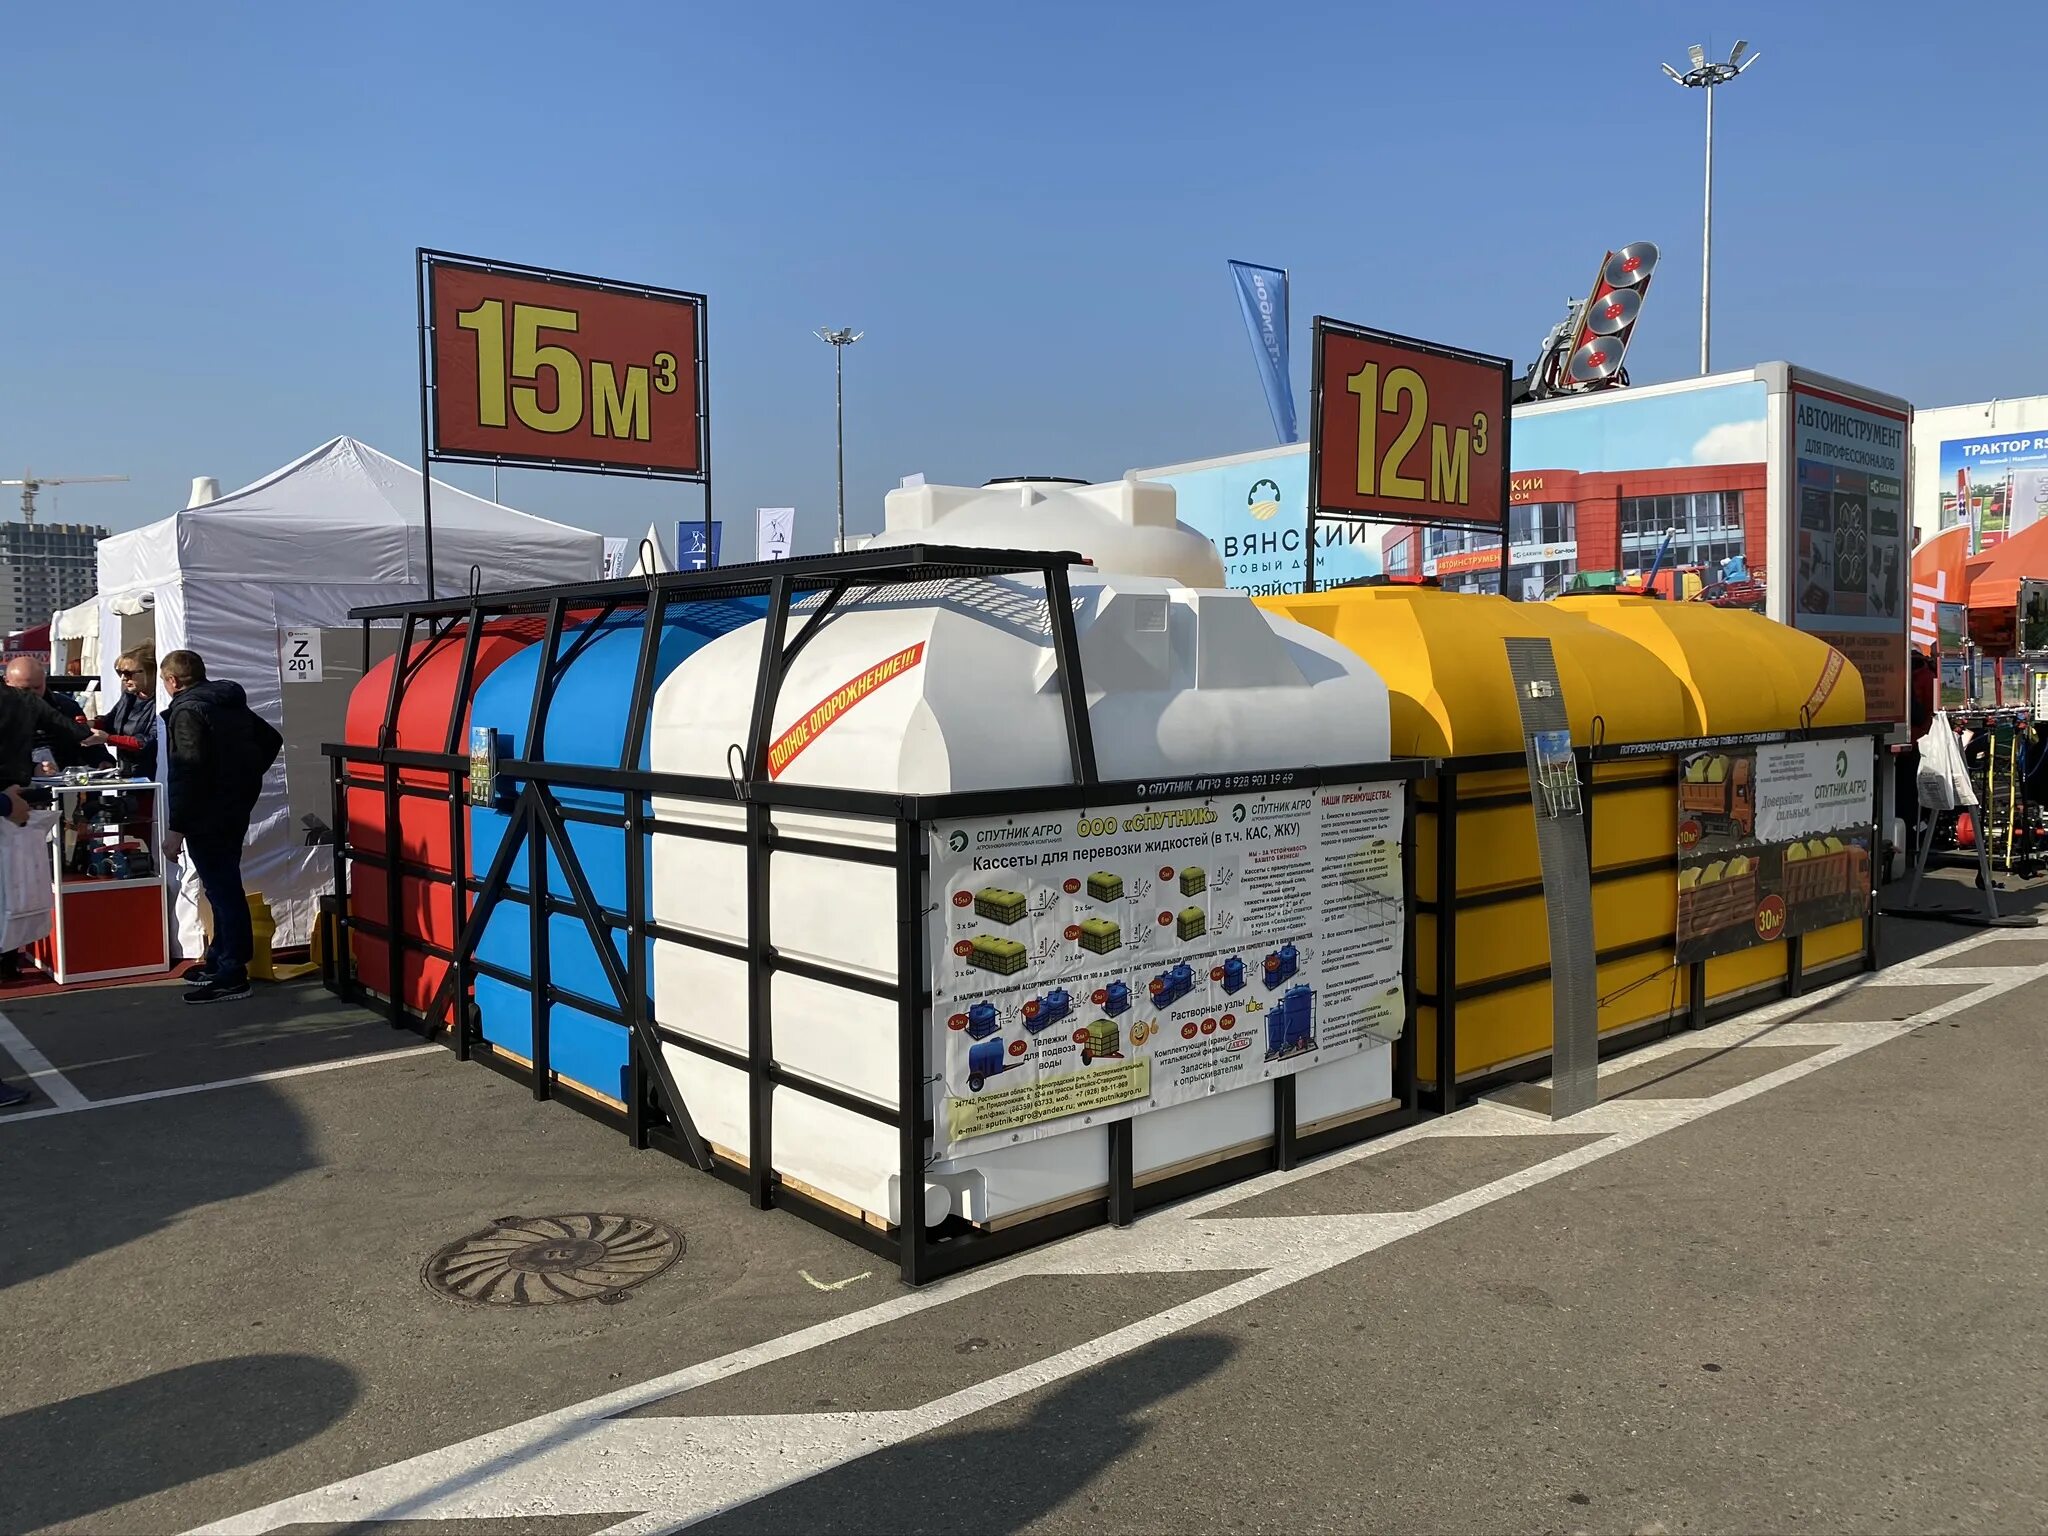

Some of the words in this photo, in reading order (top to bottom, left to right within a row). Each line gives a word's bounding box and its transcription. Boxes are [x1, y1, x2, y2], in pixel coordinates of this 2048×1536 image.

[1797, 404, 1902, 449] АВТОИНСТРУМЕНТ
[1805, 439, 1821, 456] ДЛЯ
[1823, 442, 1895, 471] ПРОФЕССИОНАЛОВ
[1963, 439, 2030, 456] ТРАКТОР
[1511, 477, 1543, 491] КИЙ
[1438, 554, 1502, 571] АВТОИНСТРУМЕН
[293, 640, 309, 658] Z
[288, 659, 314, 671] 201
[770, 720, 810, 771] ПОЛНОЕ
[810, 648, 916, 733] ОПОРОЖНЕНИЕ!!!
[1149, 779, 1193, 795] СПУТНИК
[1196, 778, 1221, 791] АГРО
[1224, 777, 1231, 788] 8
[1233, 776, 1249, 788] 928
[1251, 775, 1267, 787] 901
[1268, 774, 1282, 786] 19
[1282, 772, 1294, 784] 69
[1814, 781, 1848, 800] СПУТНИК
[1849, 779, 1867, 794] АГРО
[1251, 801, 1290, 815] СПУТНИК
[1291, 799, 1311, 810] АГРО
[1321, 796, 1340, 806] НАШИ
[1342, 790, 1391, 803] ПРЕИМУЩЕСТВА:
[1761, 792, 1804, 809] Доверяйте
[1077, 816, 1118, 838] ООО
[1122, 806, 1218, 833] «СПУТНИК»
[976, 827, 1030, 843] СПУТНИК
[1031, 823, 1062, 837] АГРО
[973, 853, 1037, 871] Кассеты
[1041, 850, 1068, 866] для
[1072, 841, 1142, 864] перевозки
[1145, 831, 1208, 853] жидкостей
[1211, 830, 1222, 849] (в
[1224, 829, 1243, 844] т.ч.
[1246, 825, 1271, 842] КАС,
[1274, 821, 1301, 839] ЖКУ)
[1245, 867, 1266, 875] Кассеты
[959, 991, 984, 1001] НАЛИЧИИ
[984, 984, 1021, 997] ШИРОЧАЙШИЙ
[1022, 978, 1057, 991] АССОРТИМЕНТ
[1057, 974, 1083, 985] ЕМКОСТЕЙ
[1171, 1003, 1222, 1021] Растворные
[1224, 1000, 1245, 1011] узлы
[1033, 1033, 1068, 1047] Тележки
[1154, 1040, 1207, 1058] Комплектующие
[1233, 1028, 1258, 1041] фитинги
[1023, 1051, 1043, 1063] для
[1042, 1044, 1076, 1059] подвоза
[1039, 1058, 1062, 1070] воды
[1160, 1051, 1201, 1066] итальянской
[1202, 1045, 1226, 1057] фирмы
[1181, 1059, 1218, 1075] Запасные
[1220, 1053, 1241, 1064] части
[1180, 1063, 1244, 1085] опрыскивателям
[978, 1091, 1009, 1104] Ростовская
[1035, 1076, 1075, 1091] Зерноградский
[1055, 1085, 1074, 1094] трассы
[957, 1123, 984, 1135] e-mail:
[1076, 1086, 1142, 1108] www.sputnikagro.ru
